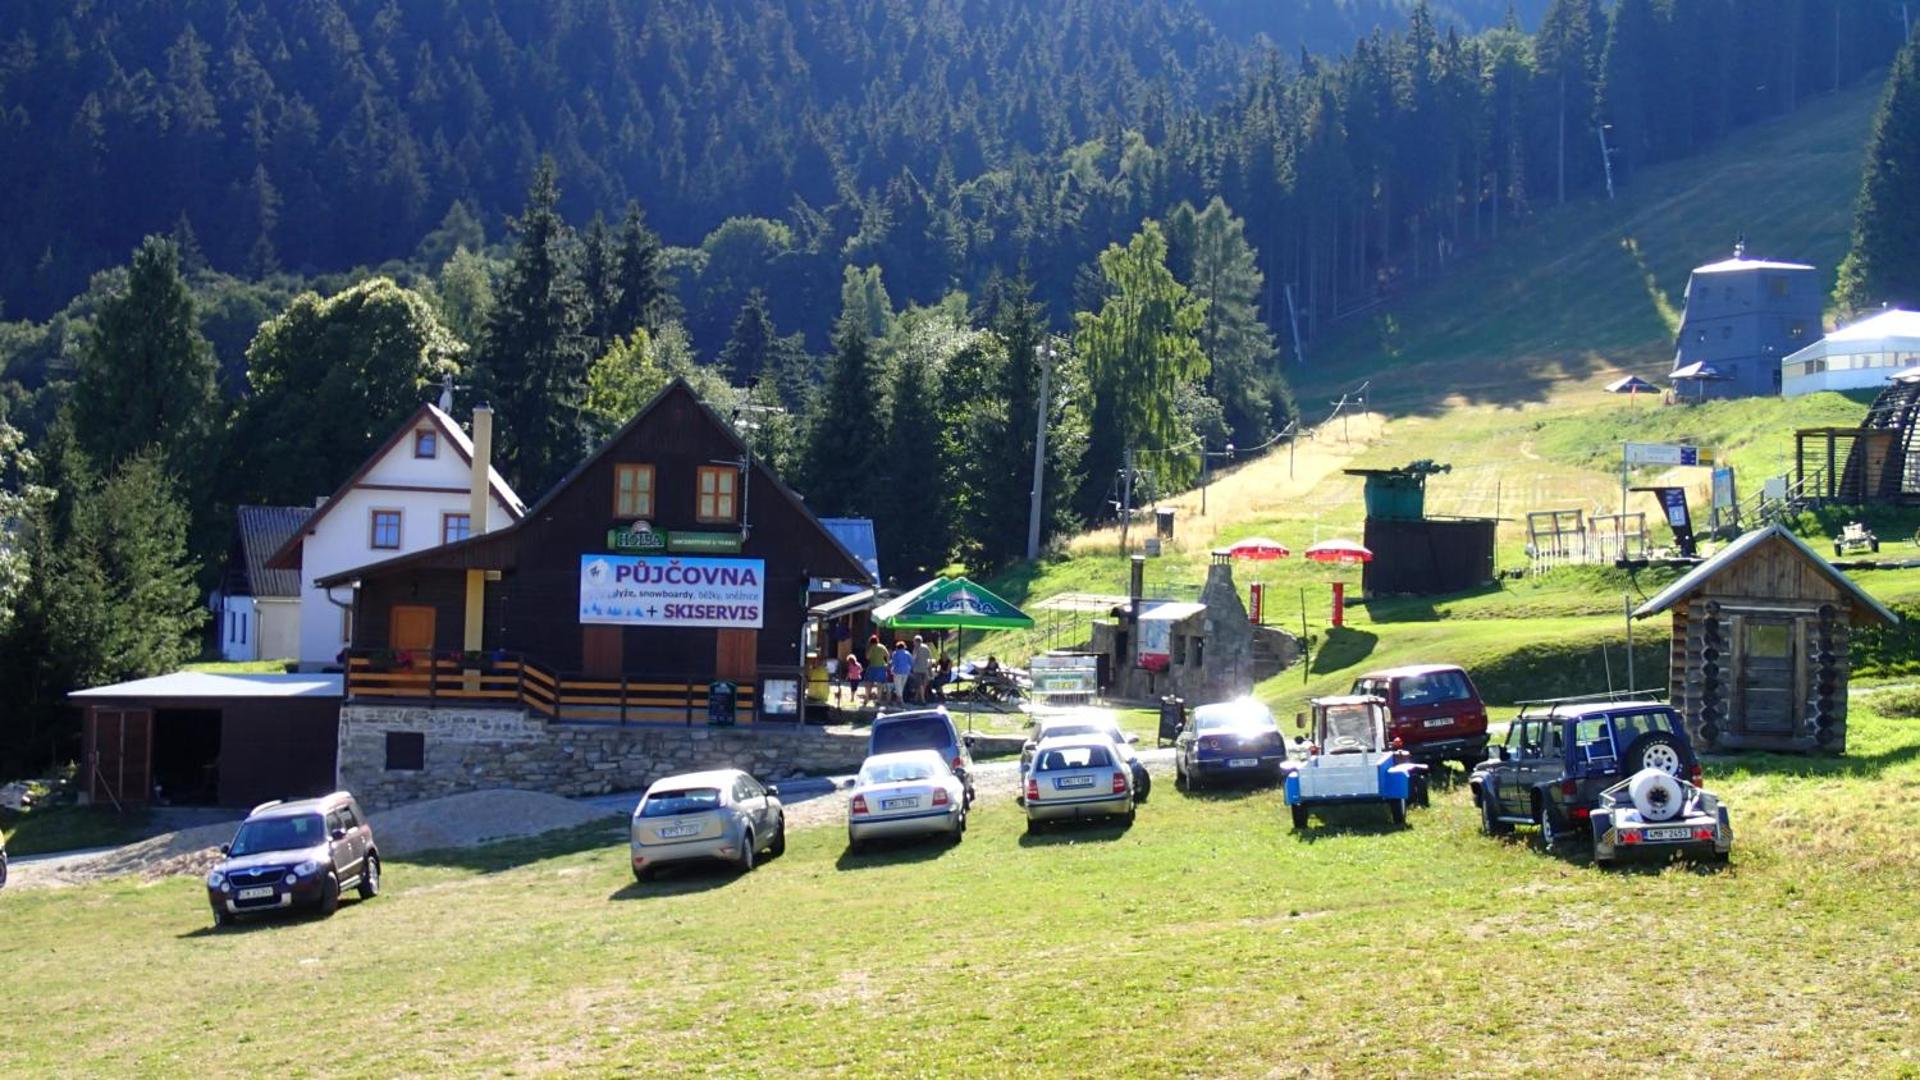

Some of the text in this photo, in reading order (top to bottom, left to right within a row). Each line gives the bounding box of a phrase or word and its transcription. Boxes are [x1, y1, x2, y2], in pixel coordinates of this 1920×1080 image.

[617, 532, 664, 547] HOLBA
[616, 561, 757, 586] PŮJČOVNA
[646, 604, 758, 620] + SKISERVIS
